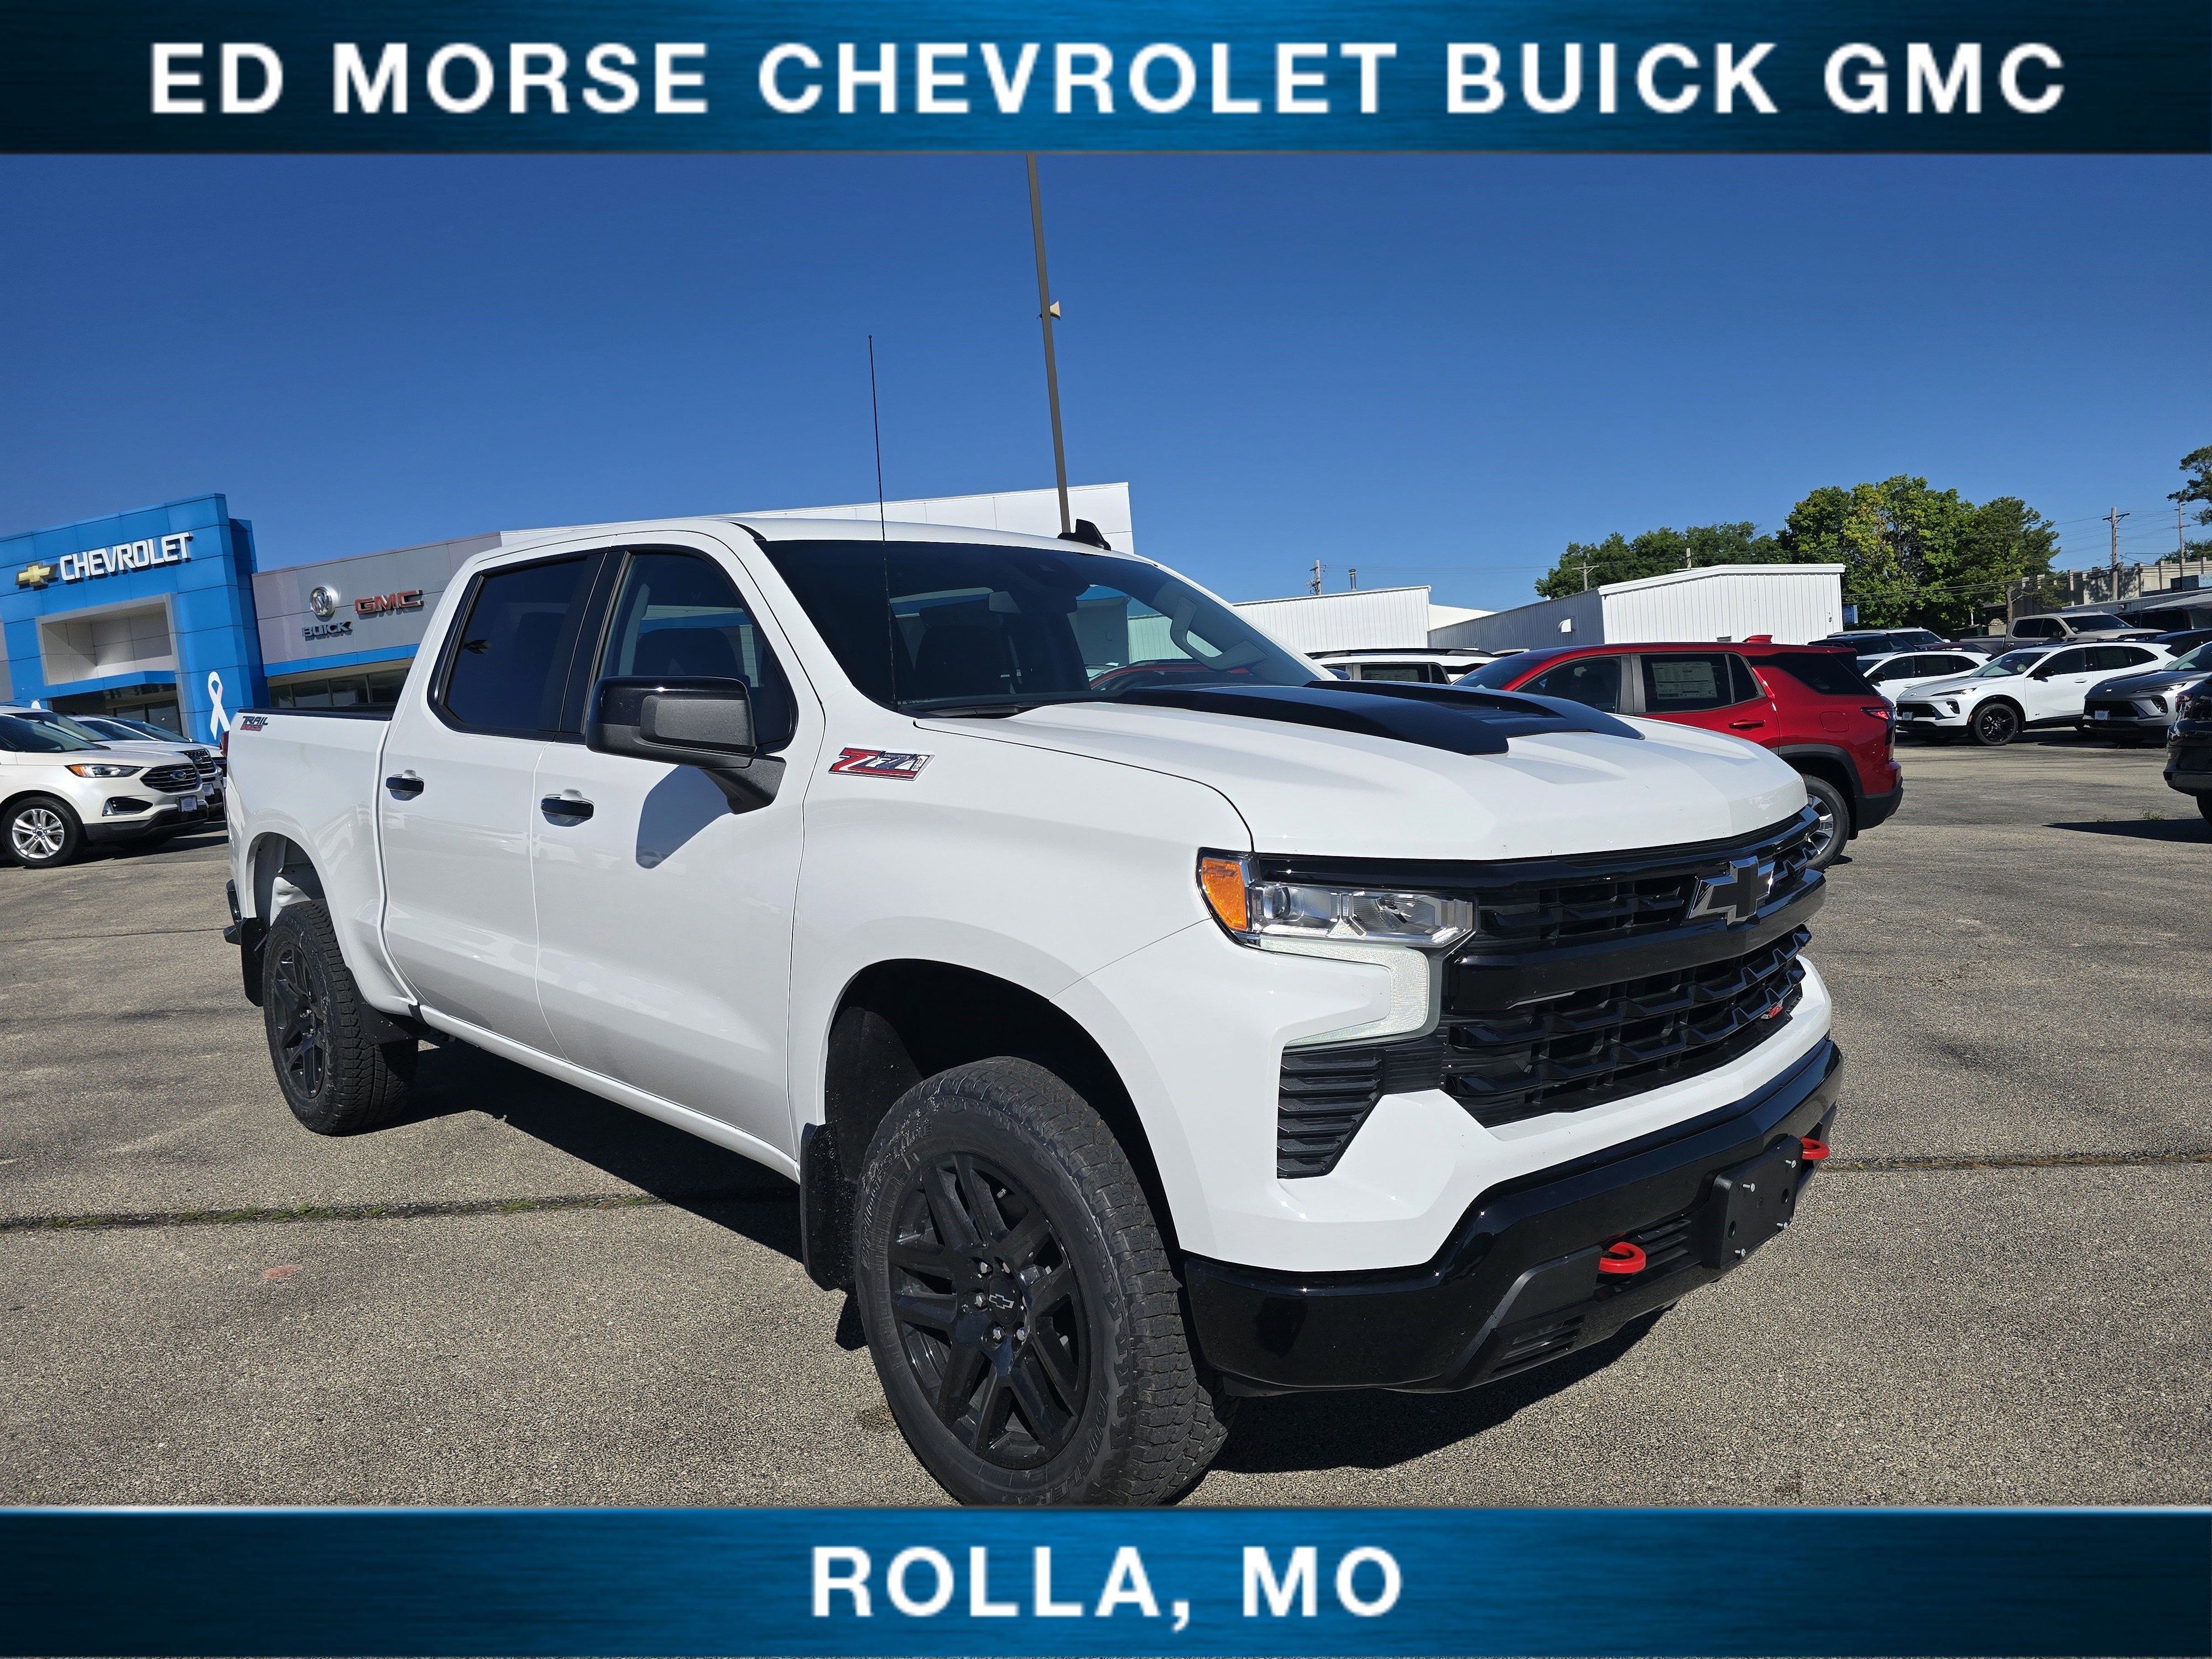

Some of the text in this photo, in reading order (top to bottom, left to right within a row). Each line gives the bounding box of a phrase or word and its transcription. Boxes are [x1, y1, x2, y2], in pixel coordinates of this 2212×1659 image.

[60, 532, 191, 581] CHEVROLET
[354, 590, 424, 614] GMC
[302, 622, 352, 637] BUICK
[242, 716, 269, 726] TRAIL
[828, 747, 931, 780] Z71
